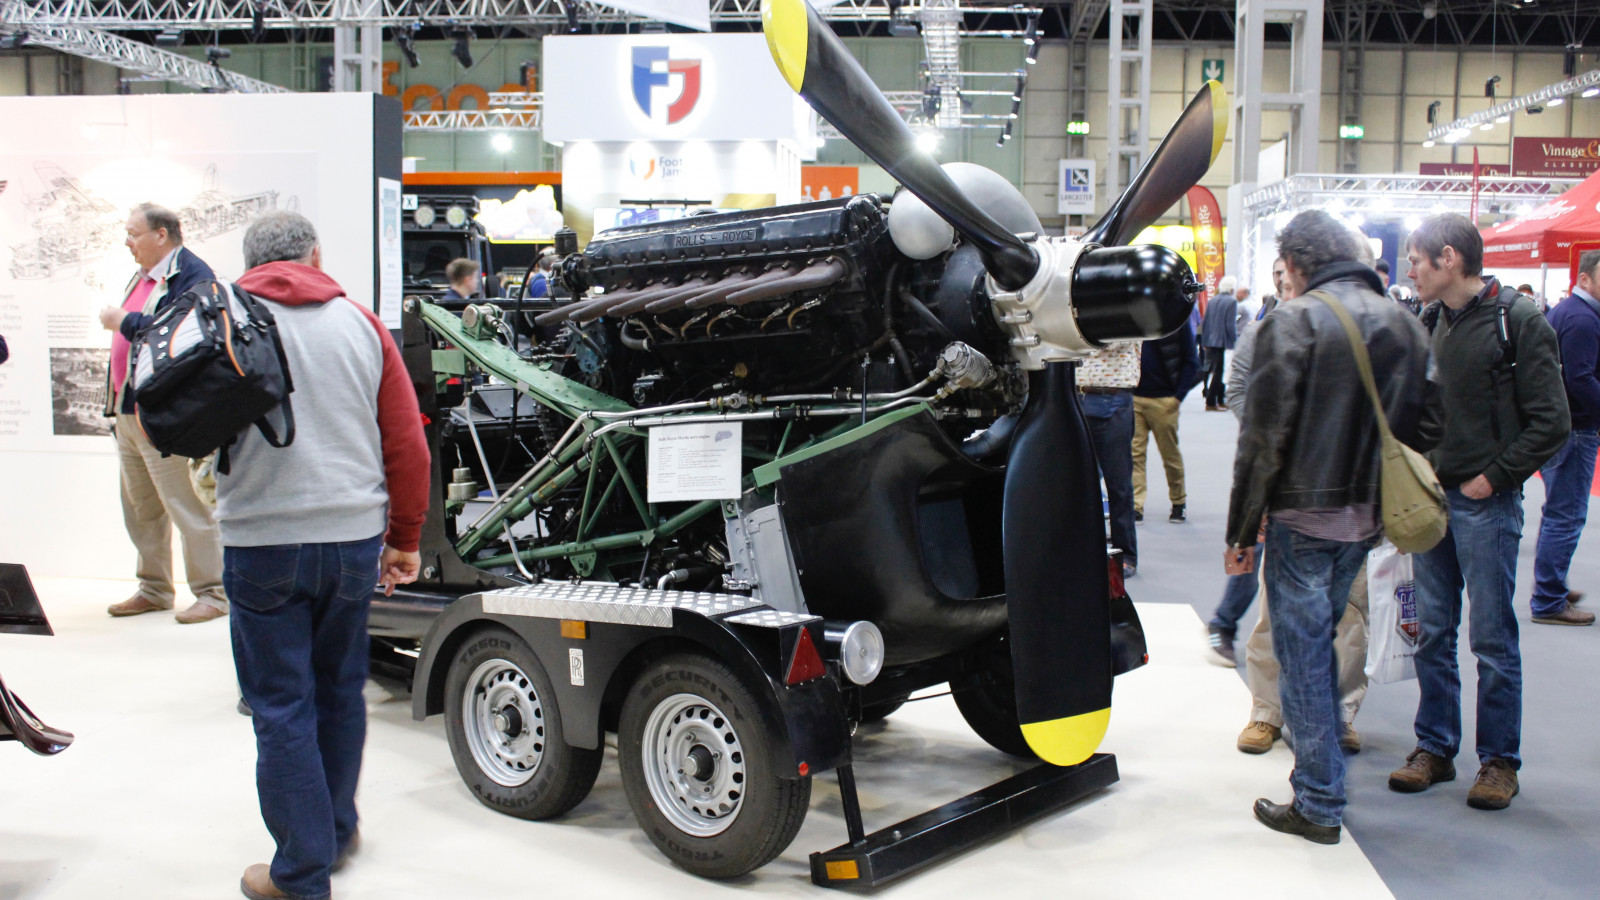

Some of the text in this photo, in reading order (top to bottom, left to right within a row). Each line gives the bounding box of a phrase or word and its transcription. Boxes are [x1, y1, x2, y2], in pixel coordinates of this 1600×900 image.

[1542, 144, 1584, 158] Vintage
[1060, 193, 1093, 201] LANCASTER
[675, 234, 706, 247] ROLLS
[722, 229, 754, 243] ROYCE
[459, 638, 512, 665] TR603
[640, 670, 745, 722] SECURITY
[473, 763, 555, 809] SECURITY
